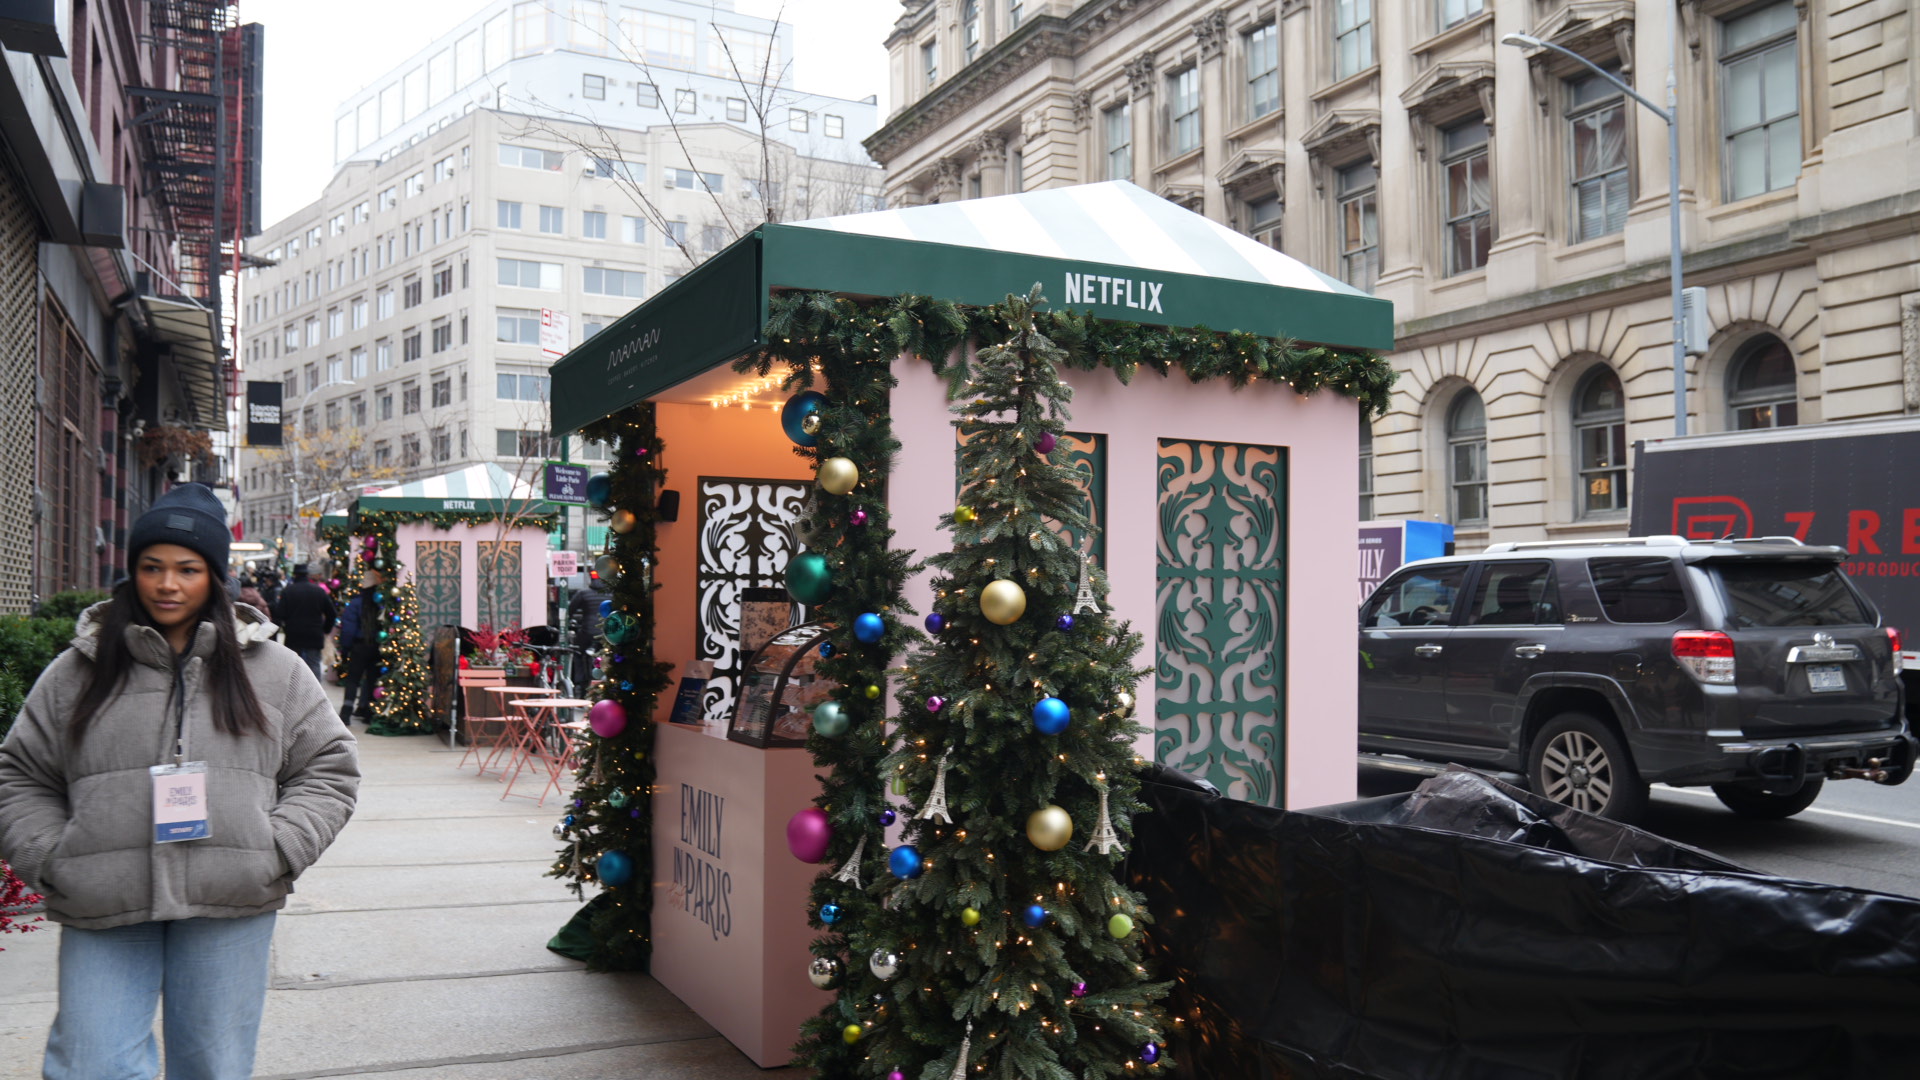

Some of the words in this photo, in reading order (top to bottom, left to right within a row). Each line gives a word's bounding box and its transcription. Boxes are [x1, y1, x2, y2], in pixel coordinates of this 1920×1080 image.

[1065, 272, 1164, 314] NETFLIX
[554, 466, 576, 475] Welcome
[556, 474, 568, 482] Little
[568, 476, 580, 484] Paris
[443, 500, 476, 510] NETFLIX
[1359, 549, 1385, 579] ILY
[681, 782, 725, 860] EMILY
[674, 846, 683, 886] IN
[684, 852, 732, 942] PARIS
